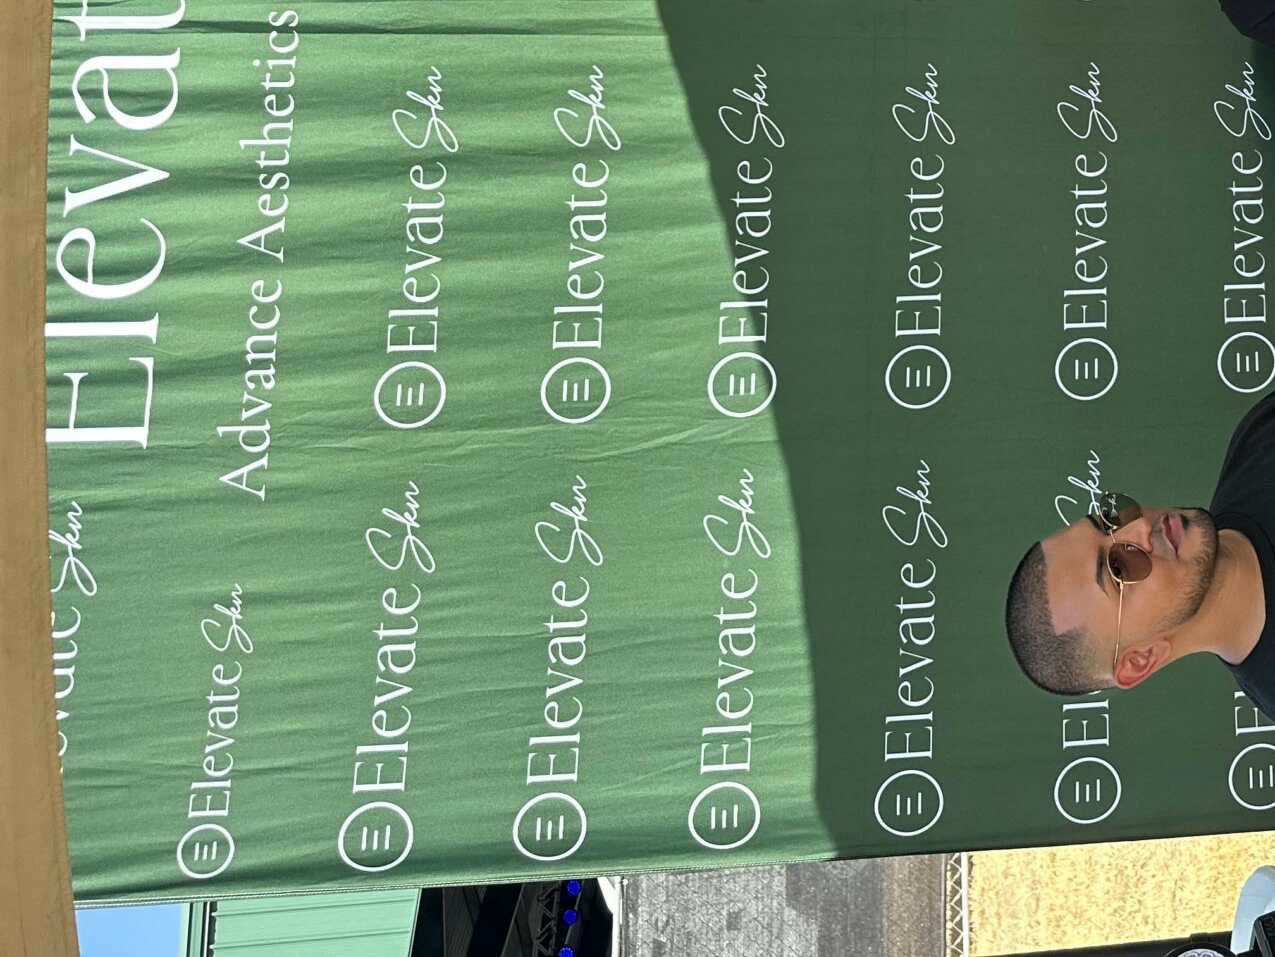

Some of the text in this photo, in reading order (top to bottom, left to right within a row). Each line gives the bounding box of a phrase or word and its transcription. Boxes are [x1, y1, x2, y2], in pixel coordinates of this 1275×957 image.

[237, 10, 299, 263] Aesthetics
[387, 162, 447, 353] Elevate
[553, 160, 609, 350] Elevate
[718, 157, 773, 345] Elevate
[895, 154, 944, 337] Elevate
[1064, 151, 1107, 331] Elevate
[1224, 149, 1266, 324] Elevate
[216, 280, 282, 501] Advance
[188, 661, 242, 818] Elevate
[352, 584, 421, 794] Elevate
[526, 577, 590, 785] Elevate
[700, 569, 758, 774] Elevate
[885, 559, 936, 762] Elevate
